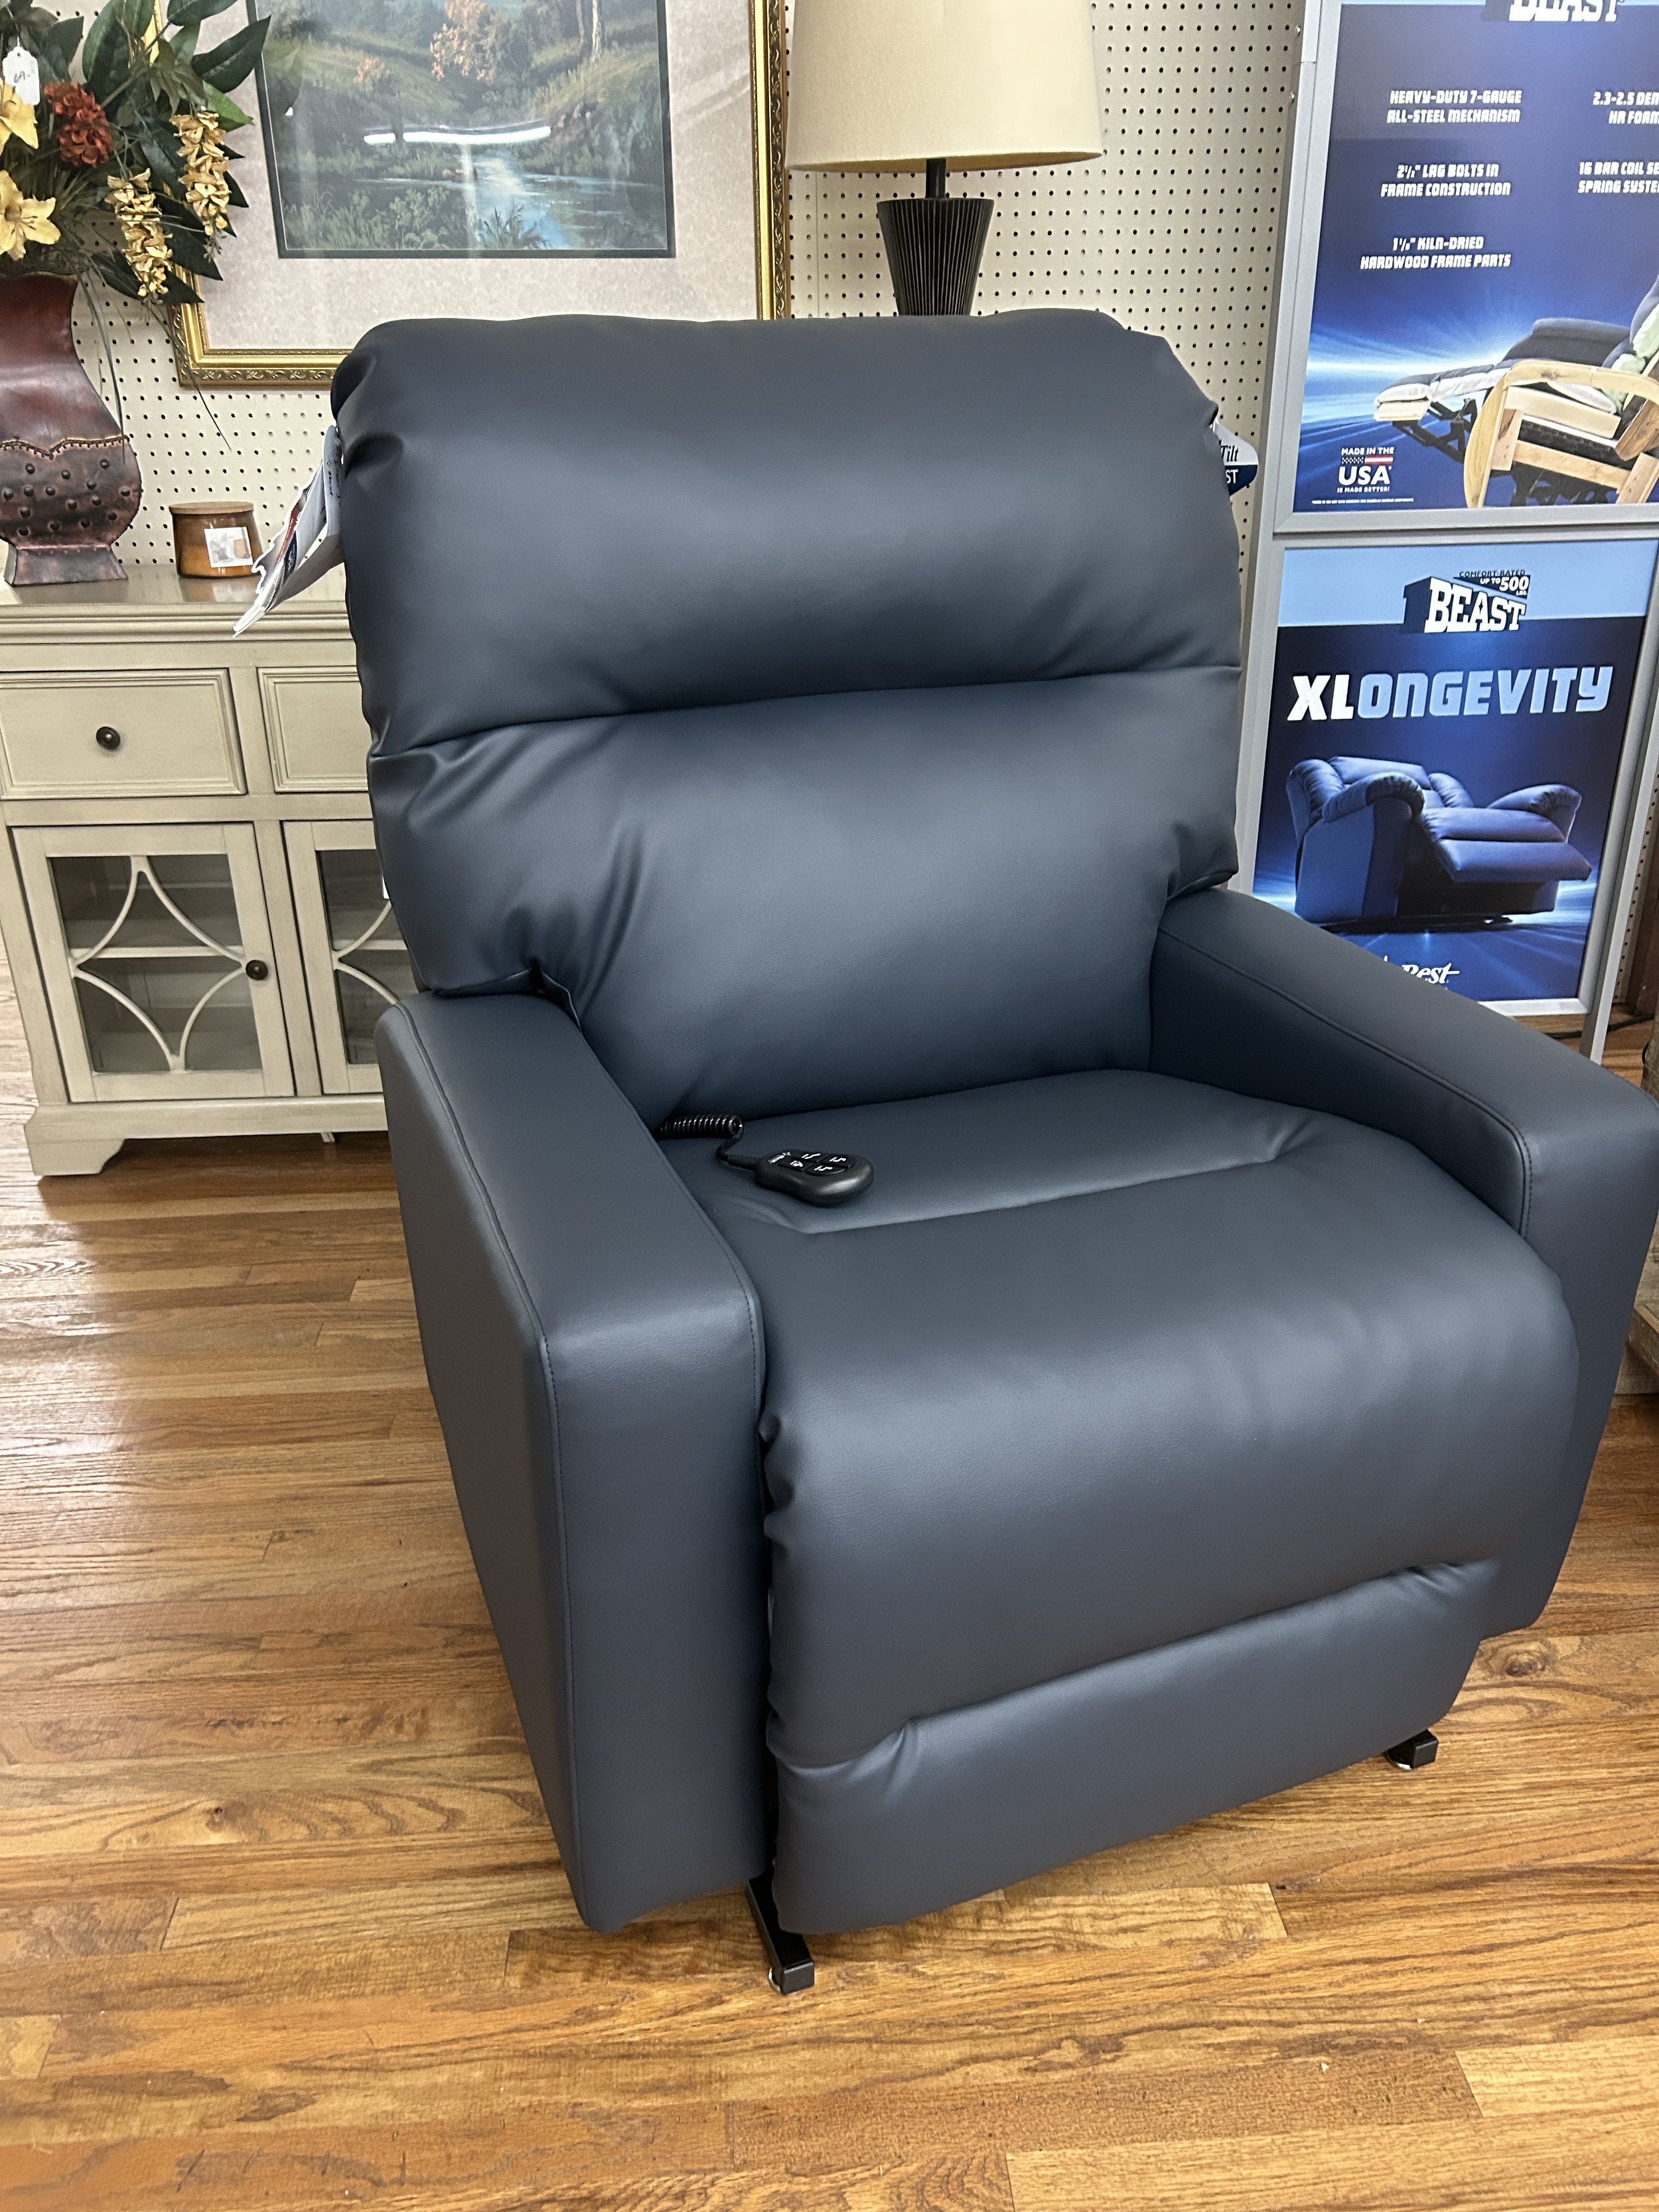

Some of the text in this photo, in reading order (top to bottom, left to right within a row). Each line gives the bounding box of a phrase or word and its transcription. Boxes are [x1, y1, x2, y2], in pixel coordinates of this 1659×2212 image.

[1390, 90, 1522, 104] HEAVY-DUTY 7-GAUGE
[1593, 91, 1635, 106] 2.3-2.5
[1386, 109, 1521, 123] ALL-STEEL MECHANISM
[1609, 110, 1626, 124] HR
[1422, 163, 1446, 178] LAG
[1447, 163, 1484, 178] BOLTS
[1486, 163, 1500, 177] IN
[1579, 161, 1593, 175] 16
[1594, 161, 1619, 175] BAR
[1621, 161, 1644, 175] COIL
[1380, 182, 1511, 197] FRAME CONSTRUCTION
[1578, 180, 1659, 193] SPRING SYSTE
[1417, 236, 1484, 250] KILN-DRIED
[1360, 254, 1512, 269] HARDWOOD FRAME PARTS
[1221, 445, 1239, 462] Tilt
[1225, 469, 1239, 484] ST
[1459, 569, 1526, 577] COMFORT-RATED
[1499, 576, 1530, 591] 500
[1424, 576, 1527, 633] BEAST
[1287, 666, 1614, 721] XLONGEVITY
